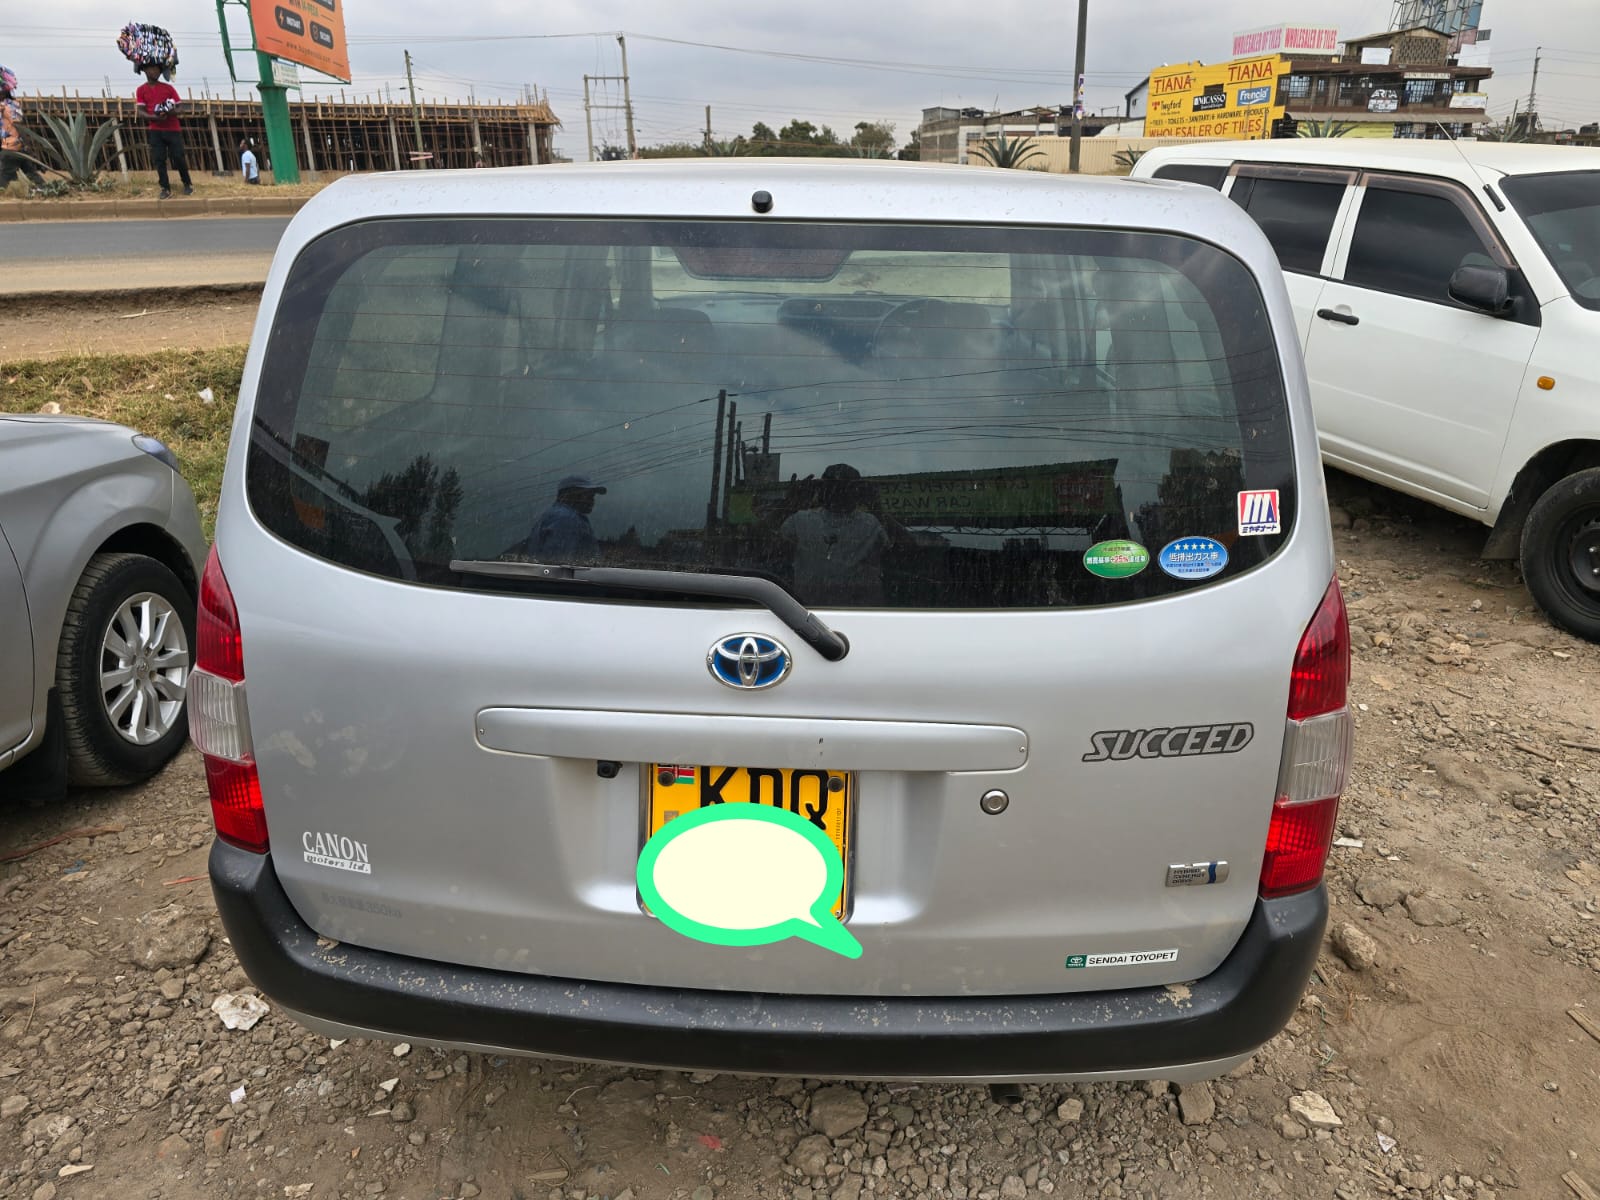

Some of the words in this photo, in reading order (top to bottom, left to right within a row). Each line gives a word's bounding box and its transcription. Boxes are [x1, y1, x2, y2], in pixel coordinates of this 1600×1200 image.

[1228, 61, 1273, 82] TIANA
[1154, 75, 1192, 94] TIANA
[1149, 124, 1214, 138] WHOLESALER
[1214, 122, 1229, 136] OF
[1232, 118, 1262, 134] TILES
[1082, 722, 1254, 762] SUCCEED
[302, 831, 369, 863] CANON
[306, 854, 345, 868] motors
[1089, 956, 1127, 965] SENDAI
[1130, 952, 1175, 962] TOYOPET
